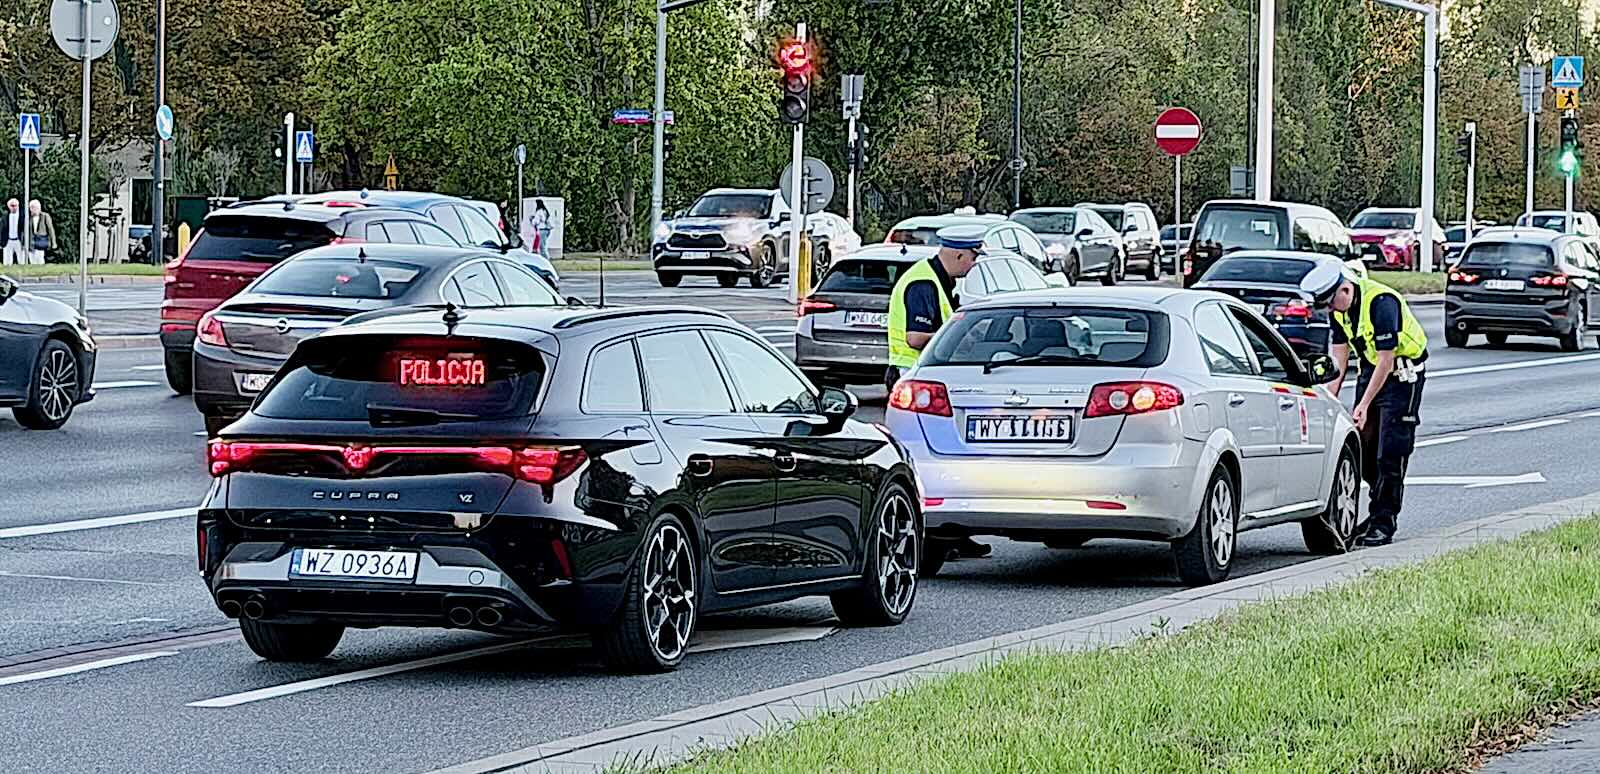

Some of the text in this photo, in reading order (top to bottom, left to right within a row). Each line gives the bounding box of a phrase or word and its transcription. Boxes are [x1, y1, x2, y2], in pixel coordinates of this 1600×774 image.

[400, 359, 485, 385] POLICJA
[980, 419, 1002, 438] WY
[312, 491, 399, 500] CUPRA
[306, 551, 407, 577] WZ 0936A
